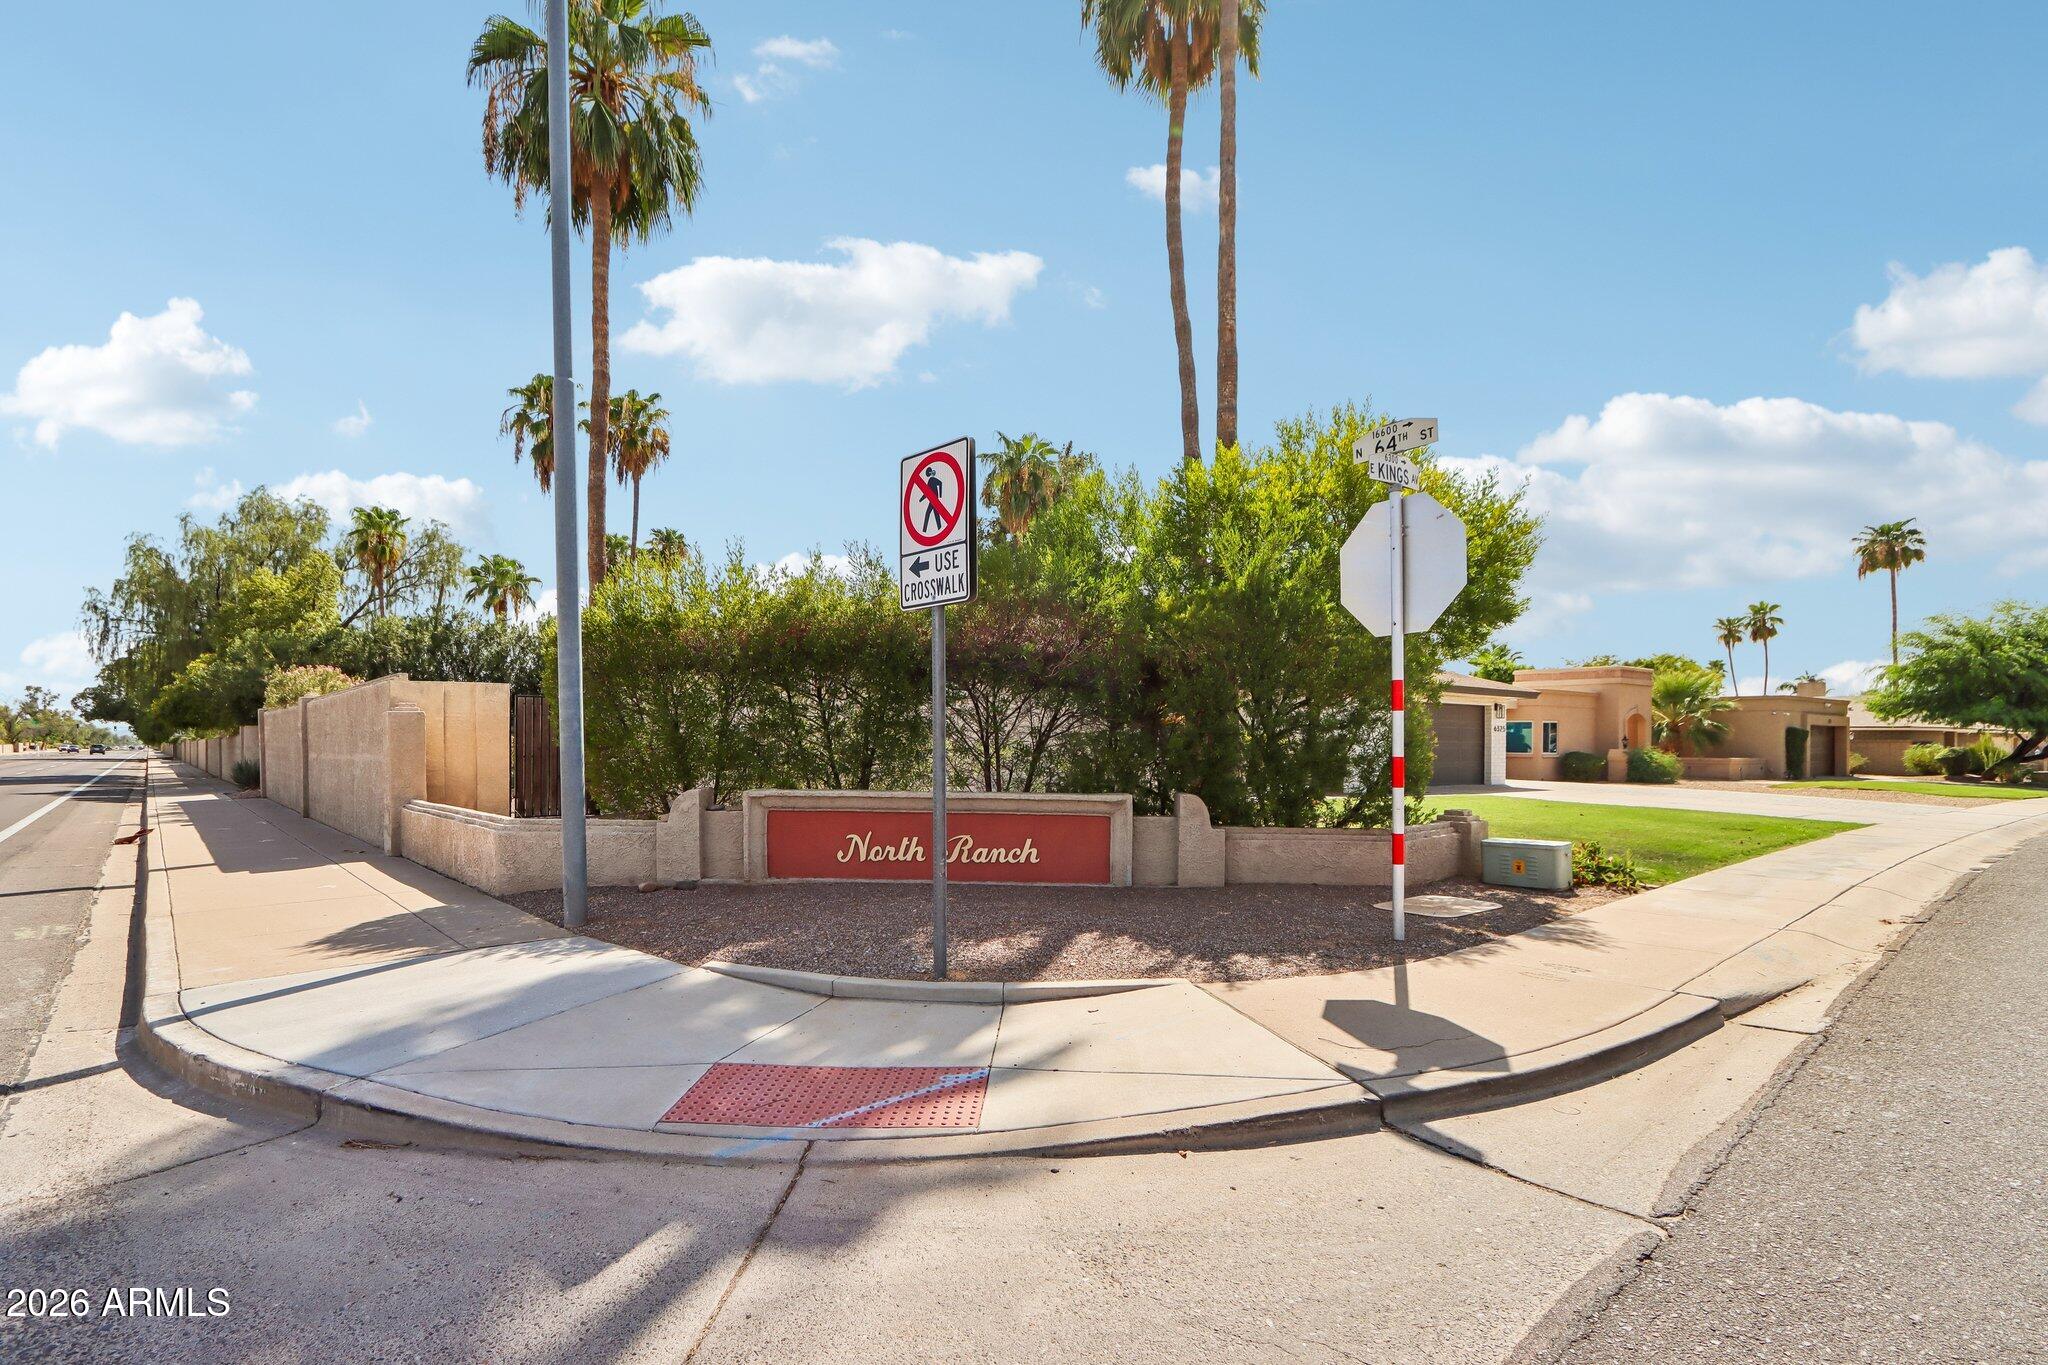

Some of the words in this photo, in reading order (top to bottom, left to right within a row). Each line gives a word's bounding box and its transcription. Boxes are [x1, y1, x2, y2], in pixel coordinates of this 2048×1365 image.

[1356, 448, 1363, 459] N
[1375, 432, 1408, 454] 64TH
[1420, 427, 1434, 440] ST
[1372, 424, 1398, 439] 16600
[1370, 462, 1375, 473] E
[1378, 462, 1409, 485] KINGS
[935, 549, 960, 572] USE
[904, 573, 965, 602] CROSSWALK
[836, 830, 926, 863] North
[945, 834, 1040, 864] Ranch
